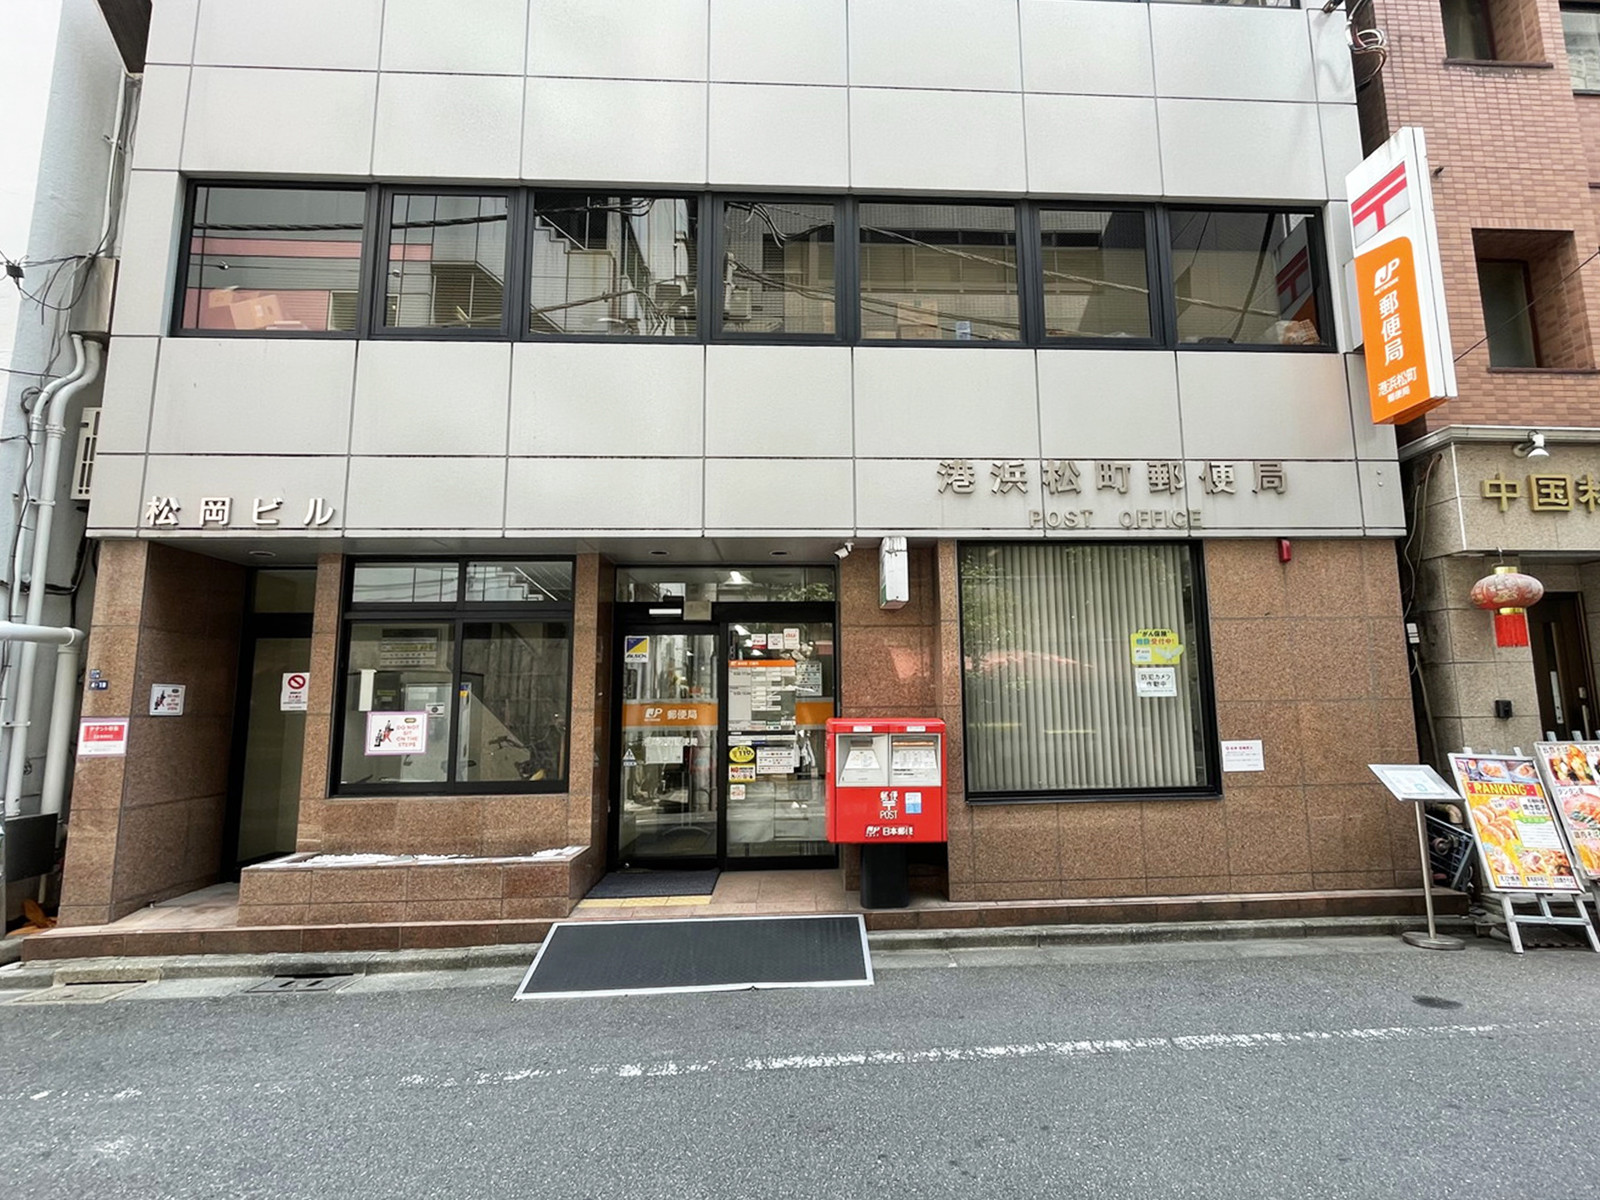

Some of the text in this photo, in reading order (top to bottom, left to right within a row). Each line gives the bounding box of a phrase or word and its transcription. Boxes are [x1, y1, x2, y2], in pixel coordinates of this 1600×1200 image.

[1378, 289, 1404, 367] 郵便局
[1377, 366, 1418, 397] 港浜松町
[936, 460, 1288, 494] 港浜松町郵便局
[145, 495, 335, 526] 松岡ビル
[1028, 509, 1203, 531] POST OFFICE
[666, 708, 698, 720] 郵便局
[1473, 782, 1528, 796] RANKING
[879, 810, 898, 820] POST
